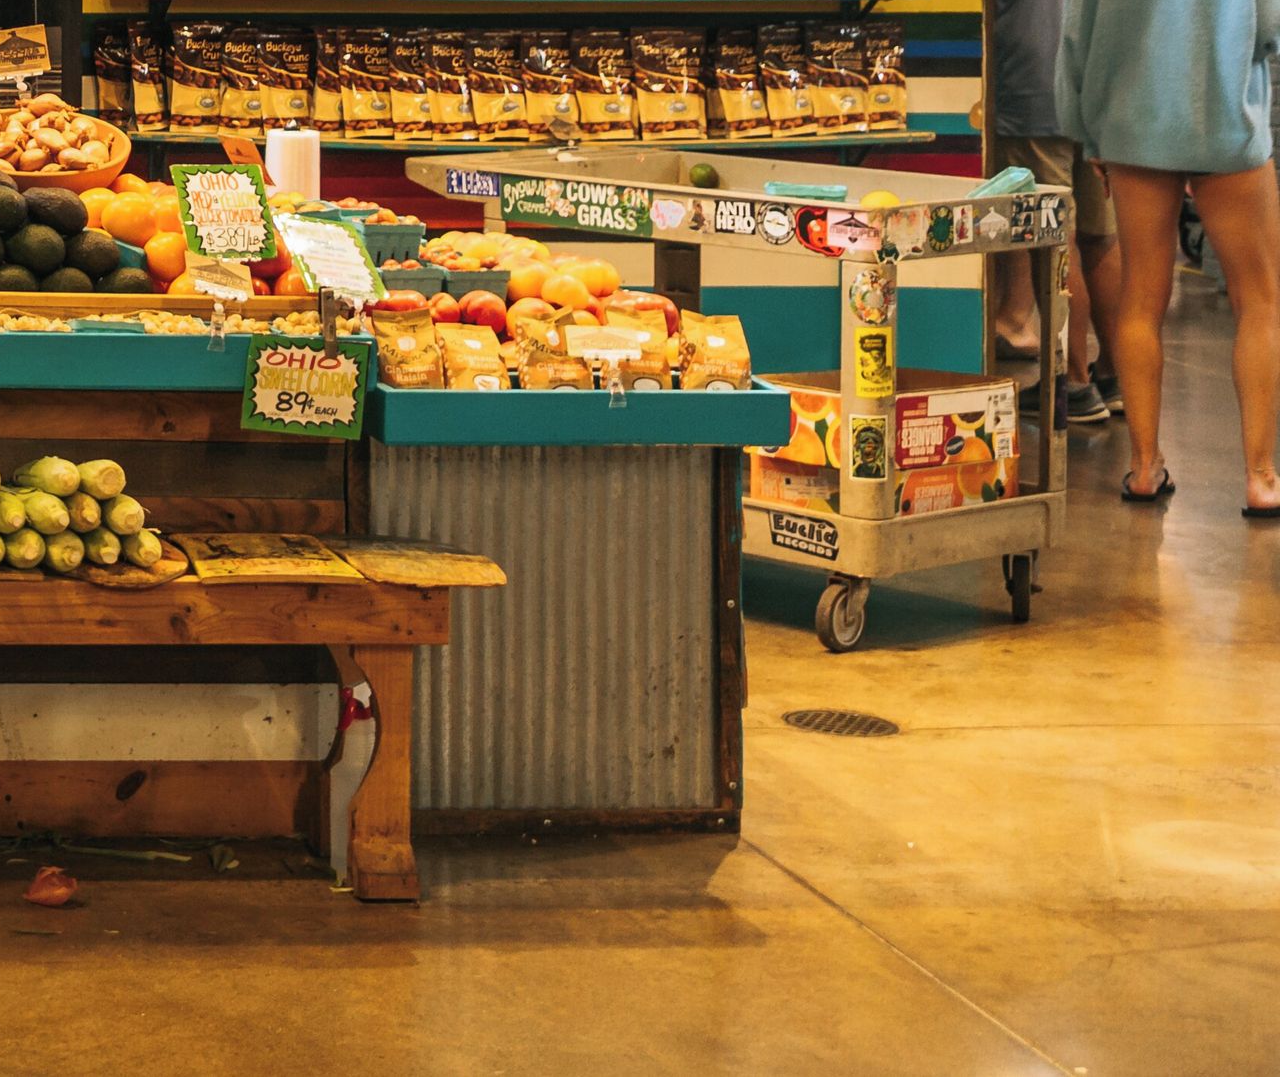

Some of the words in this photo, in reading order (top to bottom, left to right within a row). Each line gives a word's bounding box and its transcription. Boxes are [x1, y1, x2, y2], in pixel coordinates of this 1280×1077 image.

[201, 48, 221, 60] Crun
[224, 40, 253, 52] Buckey
[263, 40, 296, 52] Buckeye
[346, 43, 386, 55] Buckeye
[432, 45, 464, 57] Bucke
[279, 49, 303, 60] Crunc
[365, 54, 388, 65] Crun
[199, 174, 239, 191] OHIO
[192, 191, 213, 209] RED
[566, 182, 619, 206] COWS
[717, 200, 751, 216] ANTI
[577, 203, 638, 232] GRASS
[716, 213, 756, 233] HERO
[266, 351, 341, 370] OHIO
[259, 366, 305, 392] SWEET
[307, 369, 355, 398] CORN
[315, 406, 338, 416] EACH
[772, 513, 838, 546] Euclid
[775, 534, 834, 557] RECORDS
